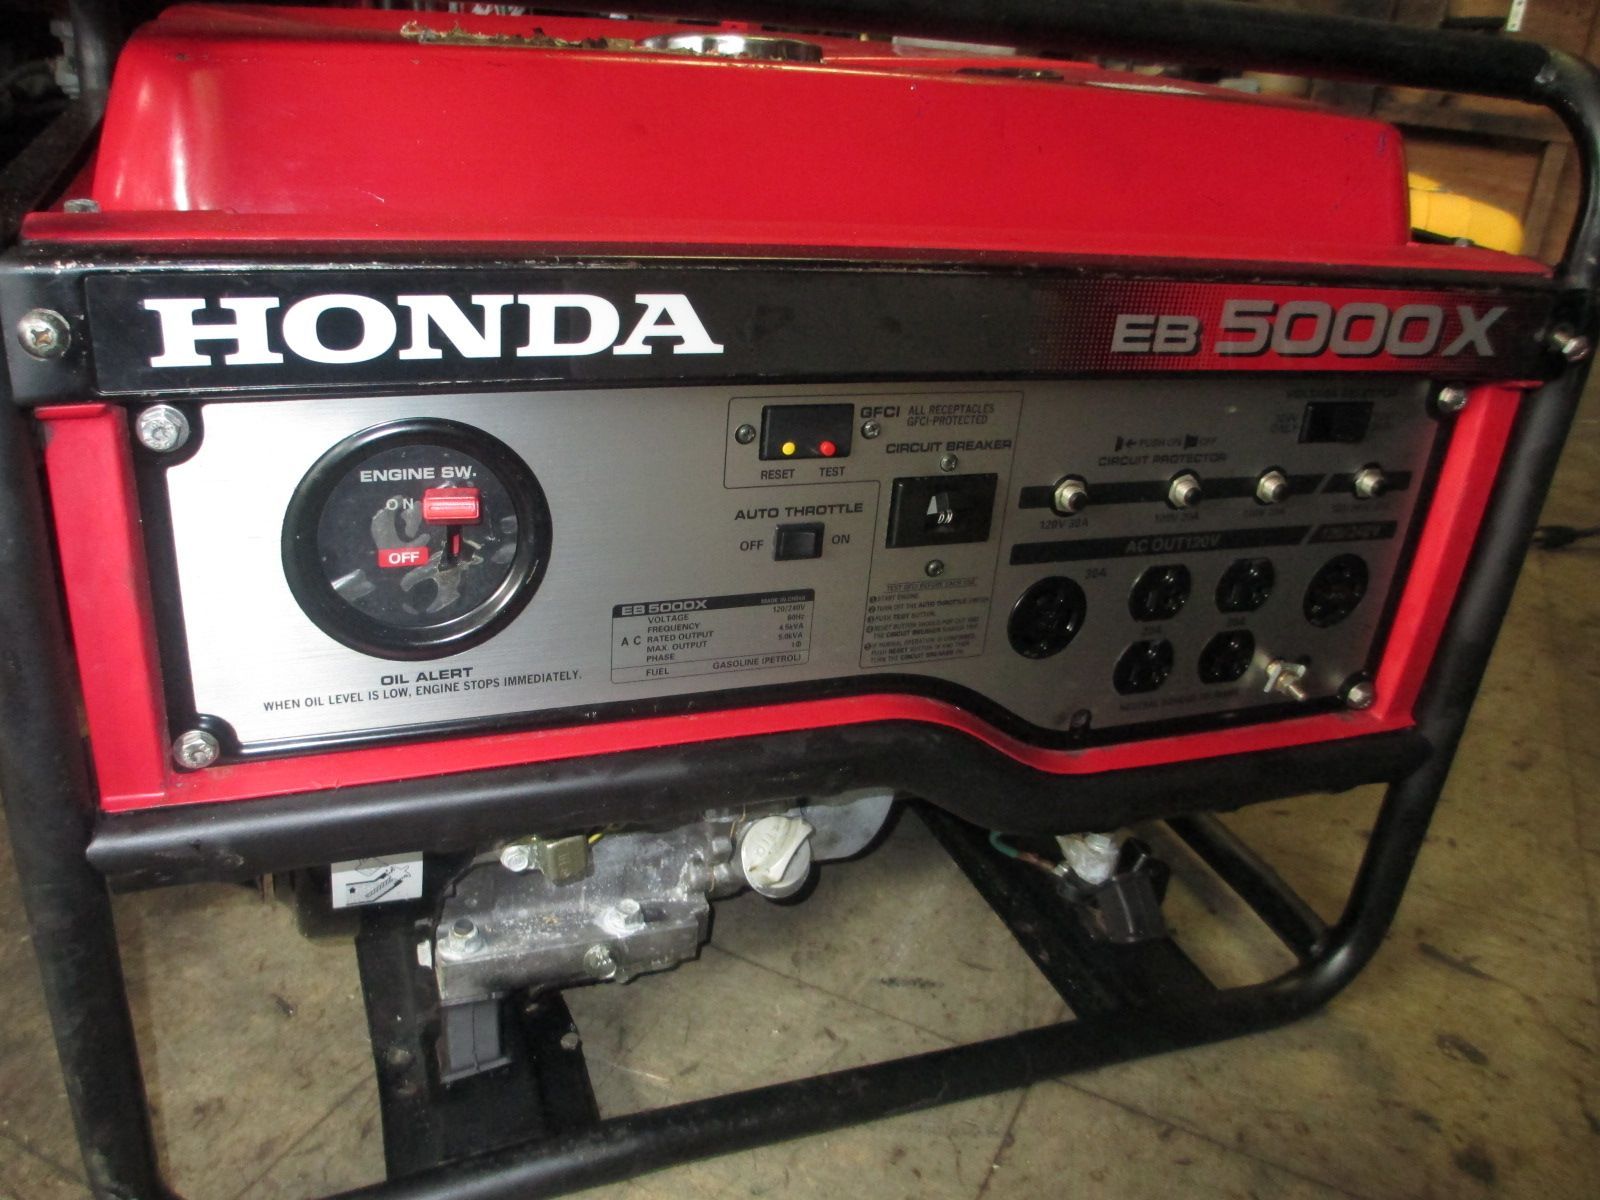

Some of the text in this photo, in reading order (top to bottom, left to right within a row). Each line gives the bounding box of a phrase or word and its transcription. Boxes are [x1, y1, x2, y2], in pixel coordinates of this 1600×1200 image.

[144, 293, 724, 368] HONDA
[1110, 299, 1508, 358] EB 5000X
[860, 406, 900, 419] GFCI
[908, 403, 995, 416] ALL RECEPTACLES
[906, 414, 989, 428] GFCI-PROTECTED
[886, 439, 1012, 455] CIRCUIT BREAKER
[1098, 452, 1228, 467] CIRCUIT PROTECTOR
[360, 465, 478, 483] ENGINE SW.
[760, 466, 846, 481] RESET TEST
[386, 498, 414, 511] ON
[735, 502, 864, 521] AUTO THROTTLE
[740, 534, 851, 552] OFF ON
[1126, 540, 1149, 553] AC
[388, 551, 420, 565] OFF
[621, 599, 709, 617] EB 5000X
[648, 614, 690, 624] VOLTAGE
[647, 622, 701, 634] FREQUENCY
[647, 630, 715, 644] RATED OUTPUT
[672, 641, 708, 651] OUTPUT
[646, 653, 675, 663] PHASE
[713, 654, 802, 670] GASOLINE (PETROL)
[381, 667, 474, 686] OIL ALERT
[646, 667, 670, 677] FUEL
[263, 698, 300, 712] WHEN
[304, 696, 325, 708] OIL
[328, 692, 364, 705] LEVEL
[368, 690, 380, 702] IS
[416, 681, 461, 697] ENGINE
[463, 677, 501, 692] STOPS
[504, 670, 583, 688] IMMEDIATELY.
